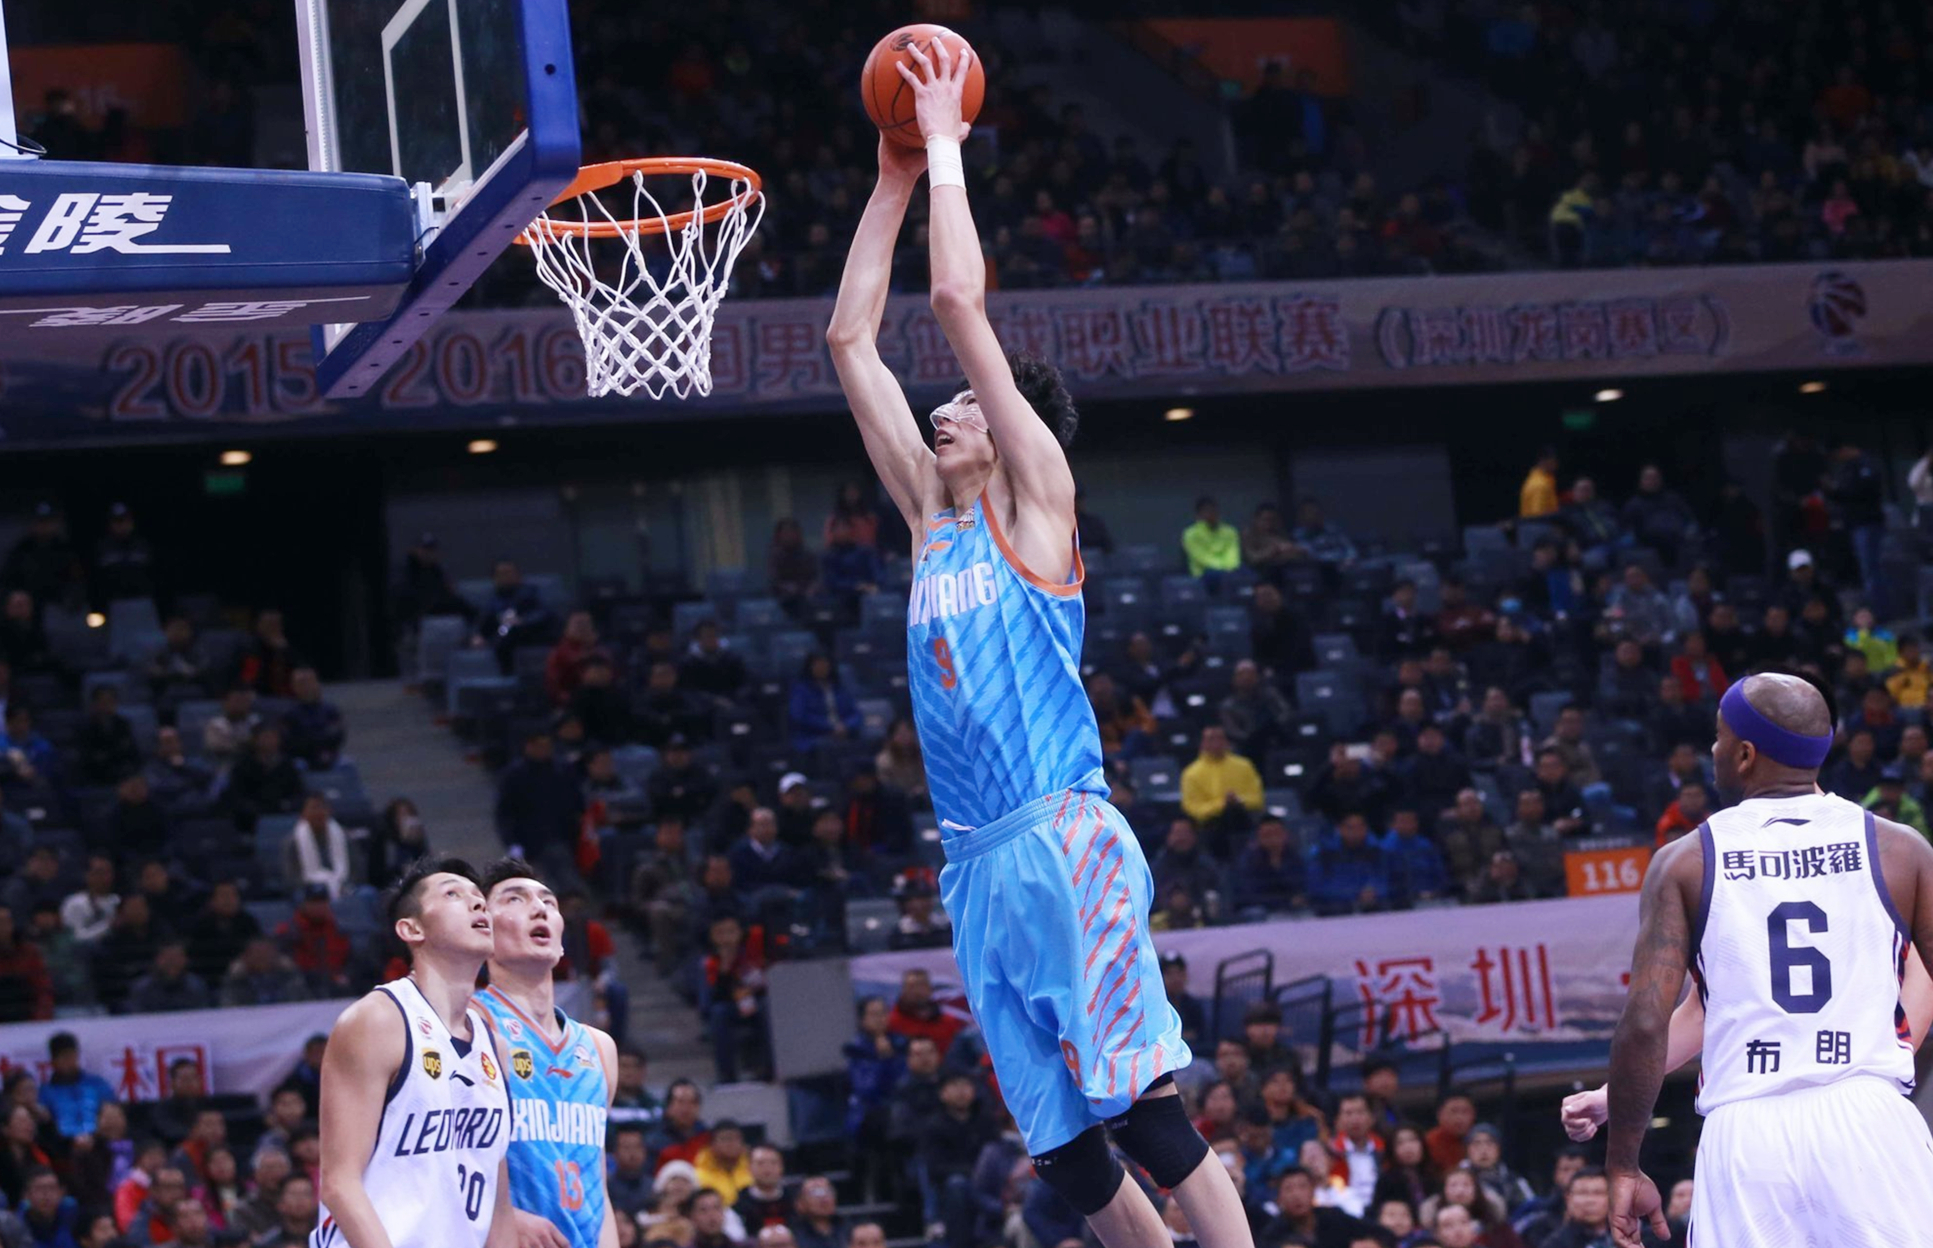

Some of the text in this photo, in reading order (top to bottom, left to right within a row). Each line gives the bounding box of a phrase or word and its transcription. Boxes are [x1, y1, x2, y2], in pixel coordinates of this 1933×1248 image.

[0, 192, 231, 254] 陵
[934, 636, 957, 690] 9
[1581, 858, 1640, 891] 116
[1722, 841, 1862, 881] 馬可波羅
[1767, 901, 1832, 1014] 6
[1354, 943, 1557, 1047] 深圳
[394, 1108, 502, 1156] LEOARD
[555, 1159, 583, 1211] 13
